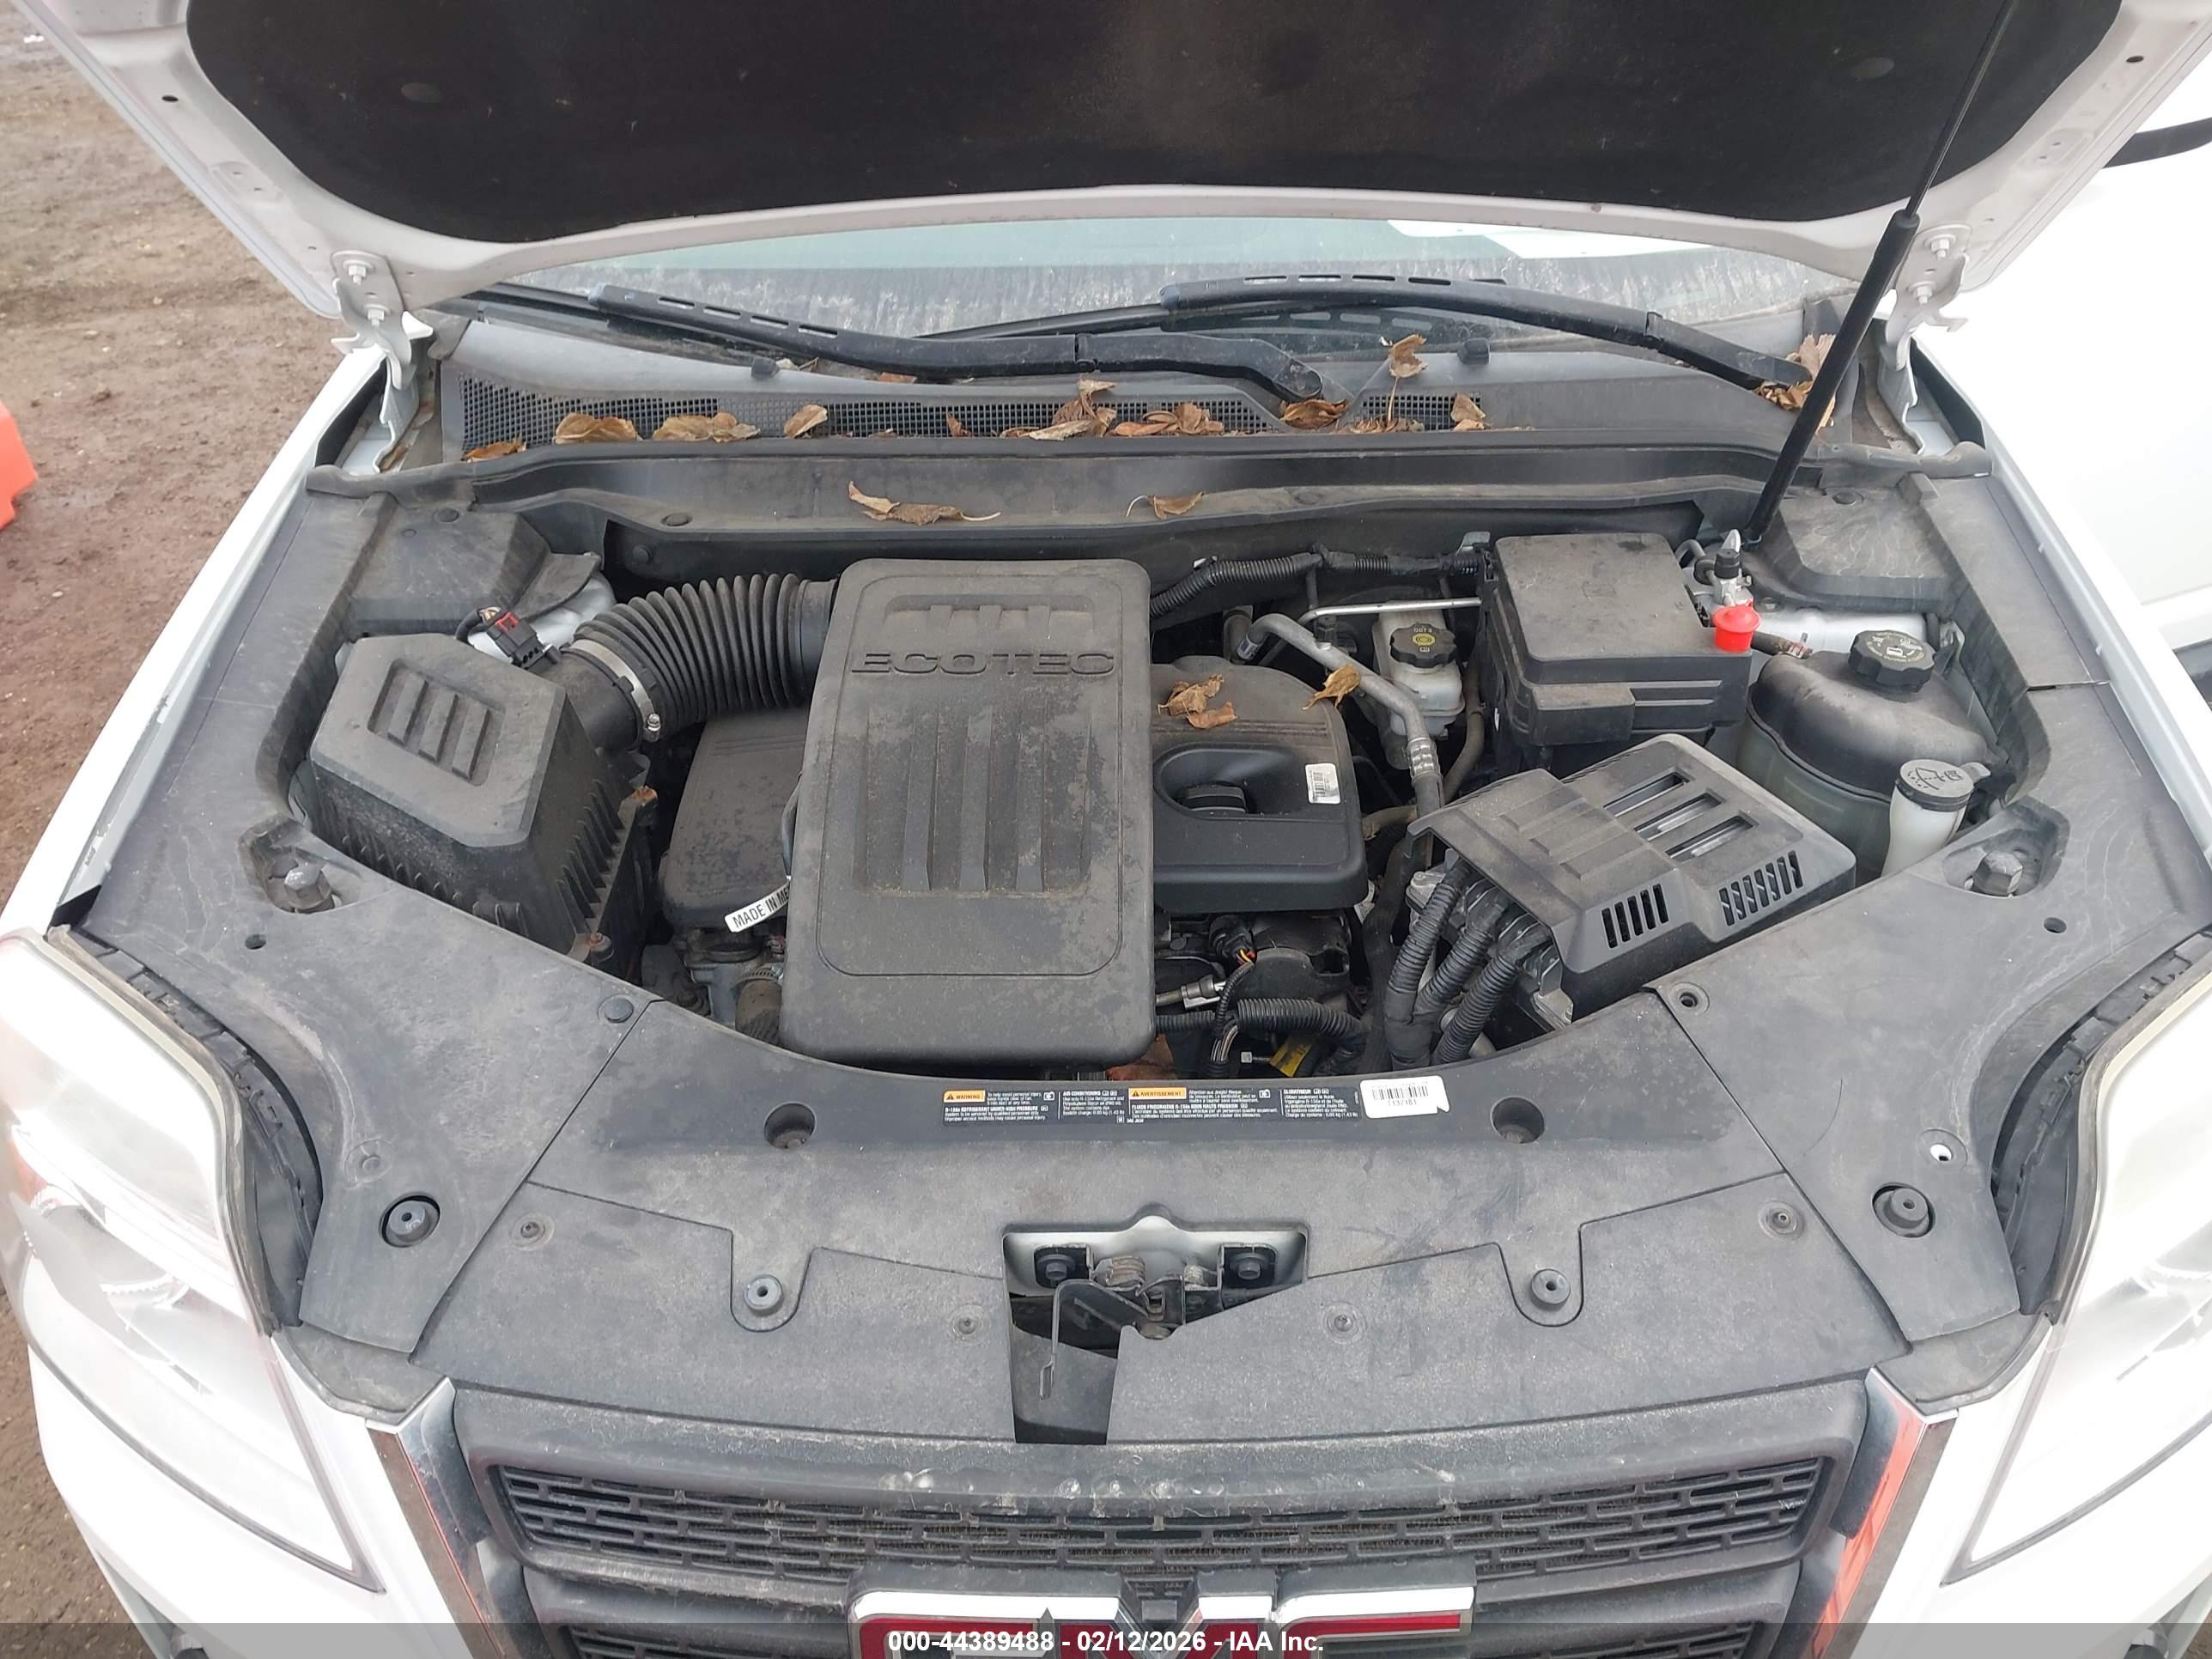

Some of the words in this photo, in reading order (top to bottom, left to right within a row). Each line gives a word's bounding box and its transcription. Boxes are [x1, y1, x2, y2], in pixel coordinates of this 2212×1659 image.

[851, 653, 1115, 676] ECOTEC
[732, 904, 766, 927] MADE
[765, 896, 778, 912] IN
